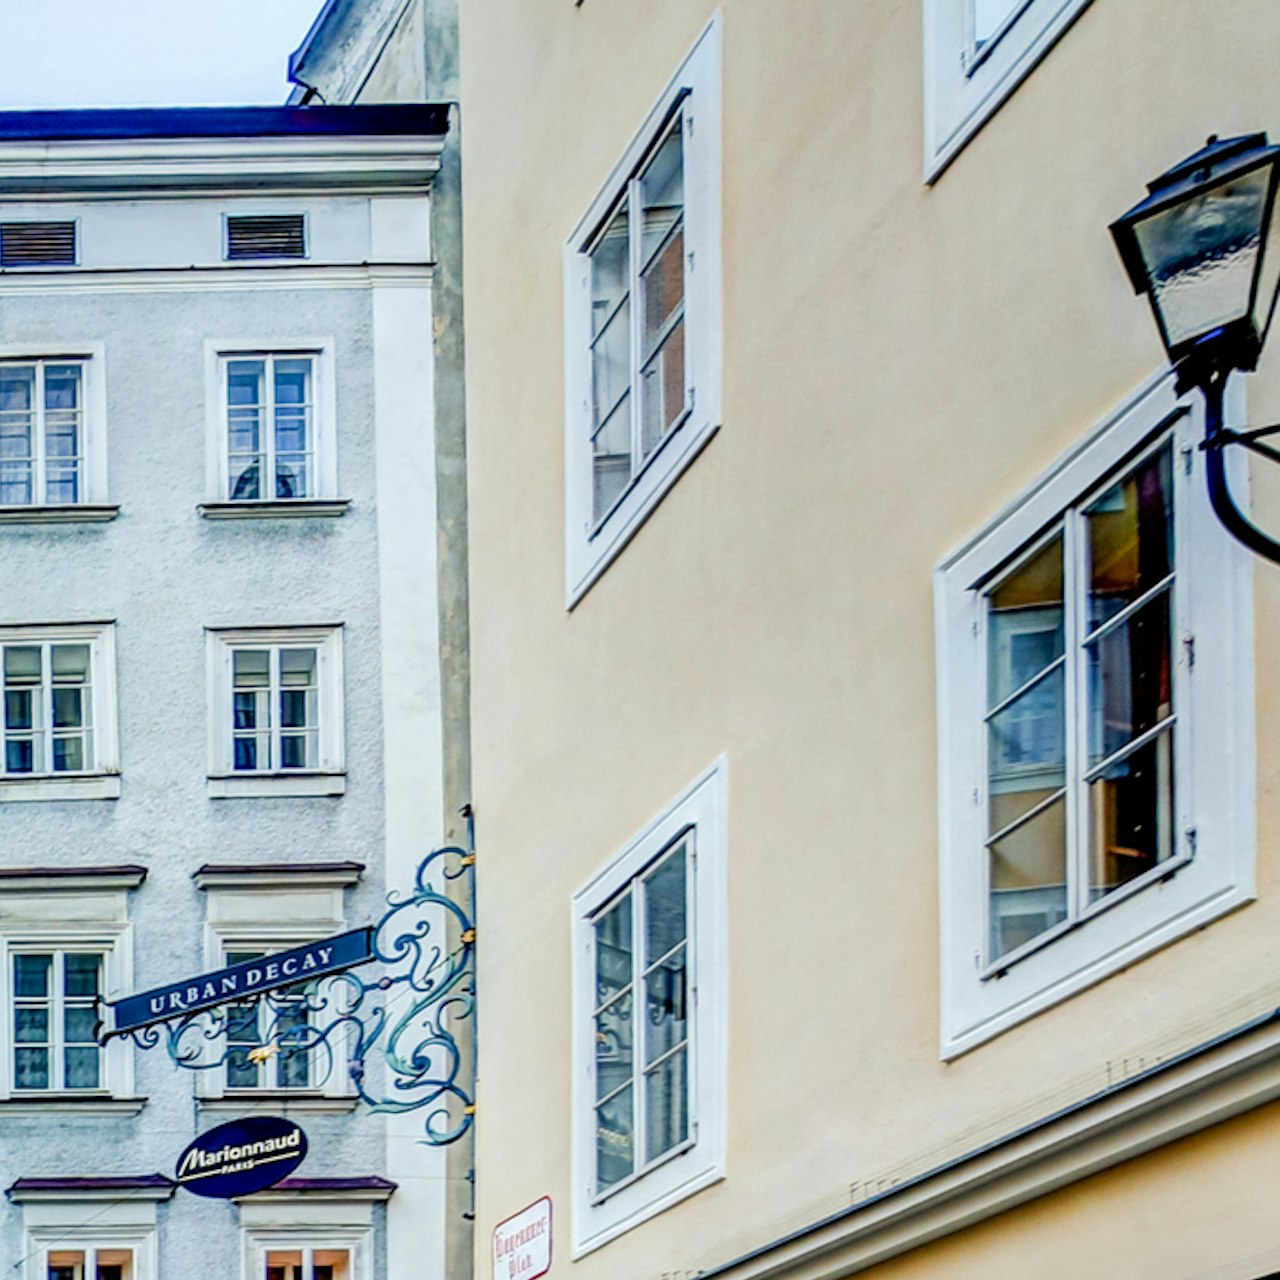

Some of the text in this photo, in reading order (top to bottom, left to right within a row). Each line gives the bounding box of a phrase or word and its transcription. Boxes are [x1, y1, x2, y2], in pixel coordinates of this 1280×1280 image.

[150, 947, 333, 1014] URBAN DECAY
[178, 1128, 300, 1177] Marionnaud
[220, 1158, 256, 1175] PARIS
